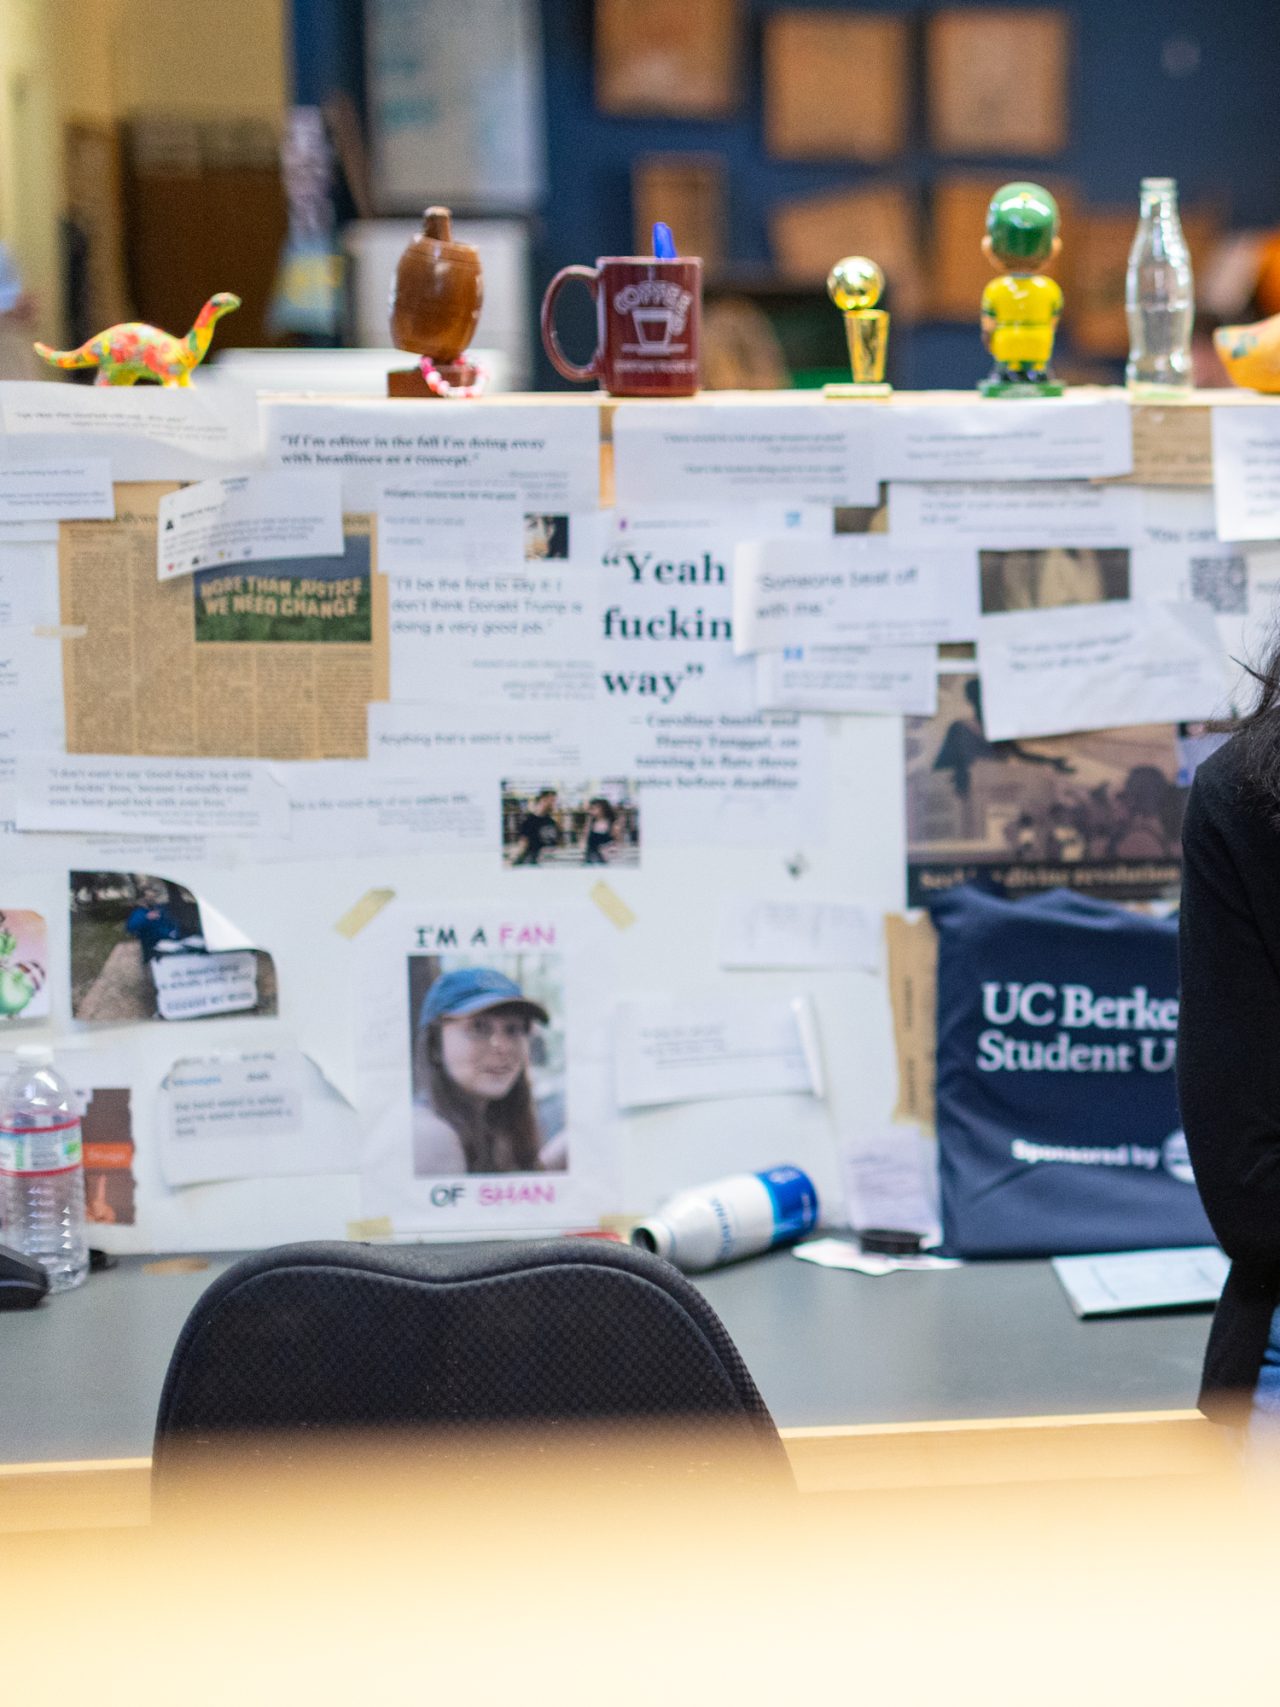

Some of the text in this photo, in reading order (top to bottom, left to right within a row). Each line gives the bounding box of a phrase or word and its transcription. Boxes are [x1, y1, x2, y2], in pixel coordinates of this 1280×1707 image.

[303, 436, 325, 447] I'm
[329, 436, 370, 448] editor
[374, 437, 387, 448] in
[391, 437, 412, 448] the
[417, 437, 439, 448] fall
[443, 437, 465, 449] I'm
[469, 437, 507, 451] doing
[511, 440, 546, 451] away
[281, 455, 311, 466] with
[315, 455, 381, 467] headlines
[385, 458, 400, 467] as
[250, 576, 290, 597] THAN
[294, 576, 363, 599] JUSTICE
[416, 578, 434, 592] be
[437, 578, 461, 592] the
[464, 578, 491, 592] first
[205, 595, 358, 618] WE NEED CHANGE
[430, 599, 464, 614] think
[468, 599, 519, 614] Donald
[523, 599, 567, 617] Trump
[482, 621, 517, 639] good
[602, 606, 733, 641] fuckin
[415, 925, 555, 948] I'M A FAN
[981, 981, 1180, 1031] UC Berke
[977, 1029, 1136, 1074] Student
[1011, 1137, 1161, 1170] Sponsored by
[430, 1185, 555, 1207] OF SHAN
